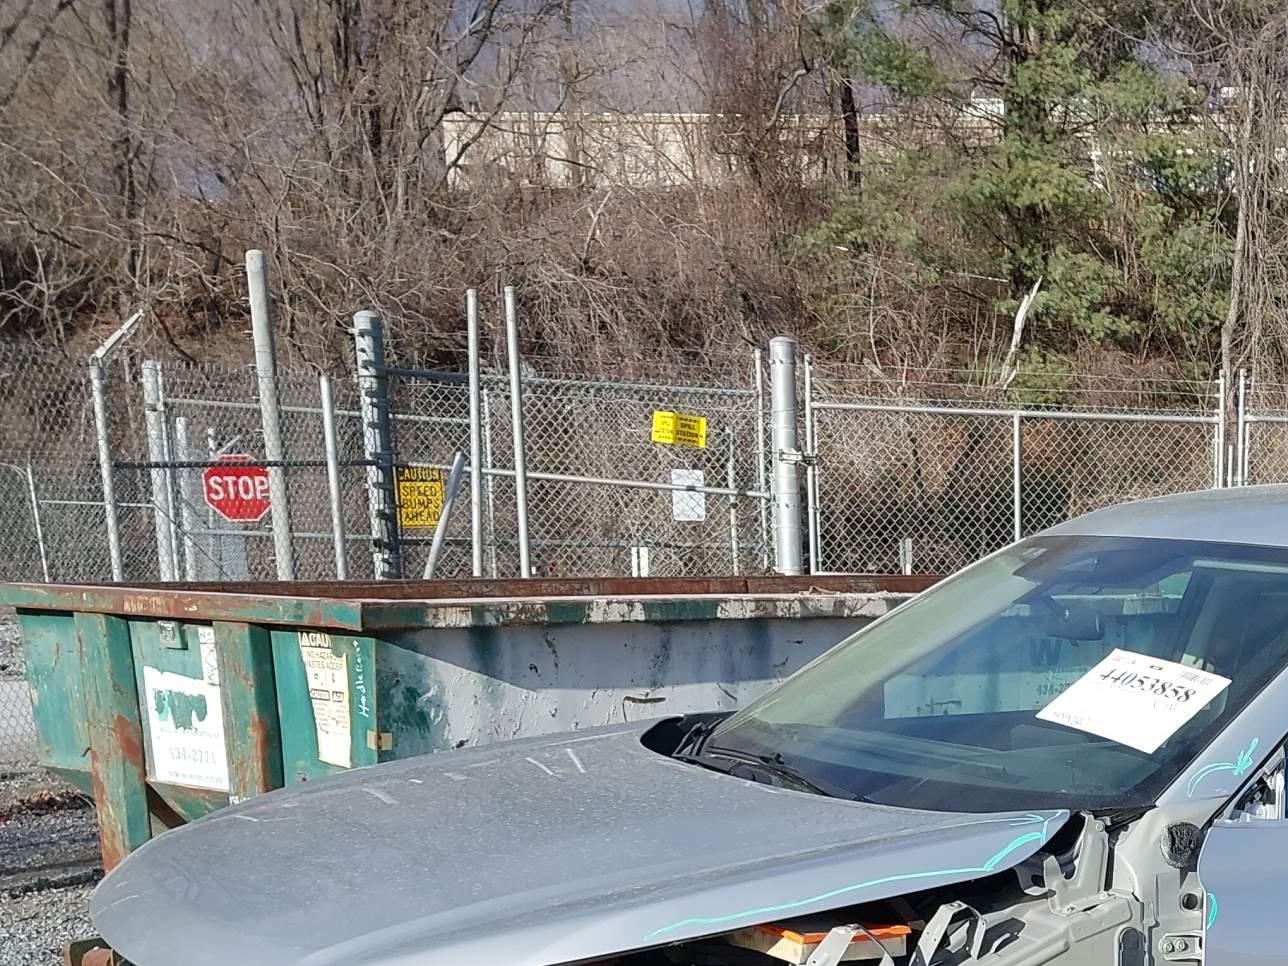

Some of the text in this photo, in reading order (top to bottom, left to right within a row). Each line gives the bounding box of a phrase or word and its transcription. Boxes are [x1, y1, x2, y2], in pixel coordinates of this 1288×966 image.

[208, 475, 269, 501] STOP
[401, 486, 437, 497] SPEED
[402, 498, 440, 510] BUMPS
[404, 511, 441, 522] AHEAD
[309, 633, 331, 648] CAU
[1100, 668, 1197, 703] 44053858
